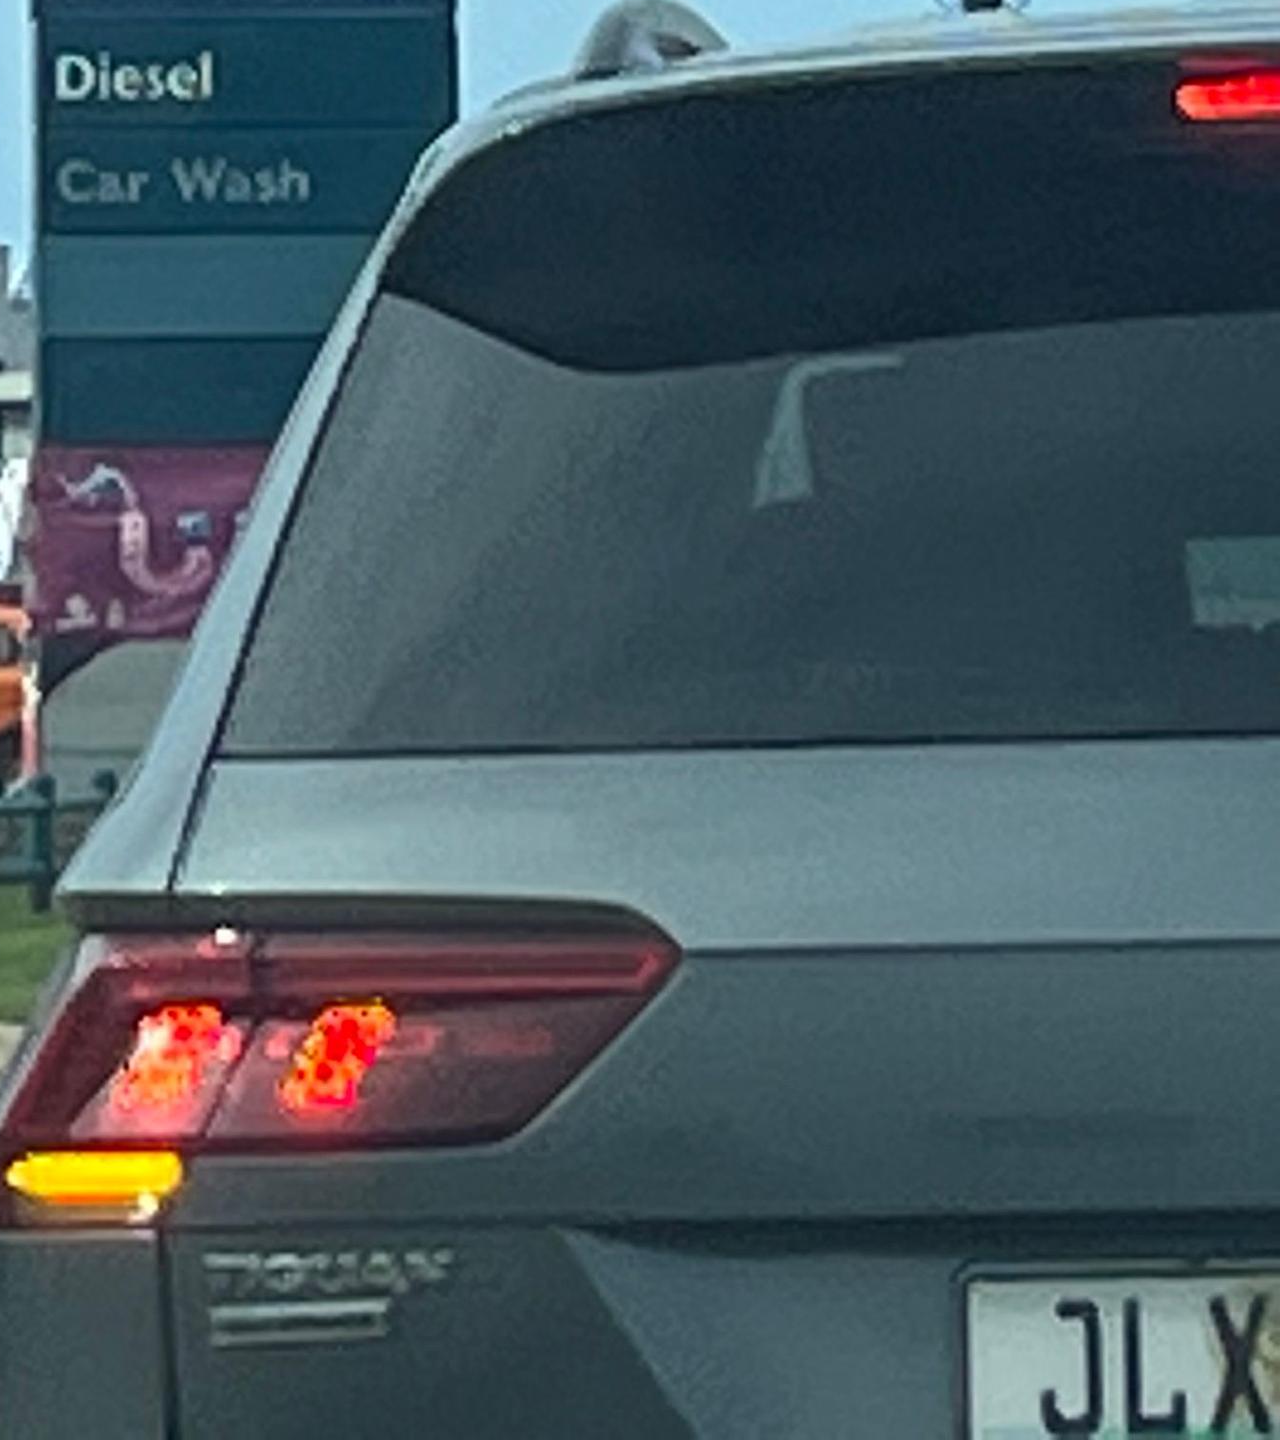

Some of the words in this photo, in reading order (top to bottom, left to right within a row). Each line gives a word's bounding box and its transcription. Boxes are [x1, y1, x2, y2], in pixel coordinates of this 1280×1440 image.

[55, 50, 214, 102] Diesel
[57, 159, 149, 204] Car
[171, 157, 310, 204] Wash
[1041, 1293, 1273, 1435] JLX
